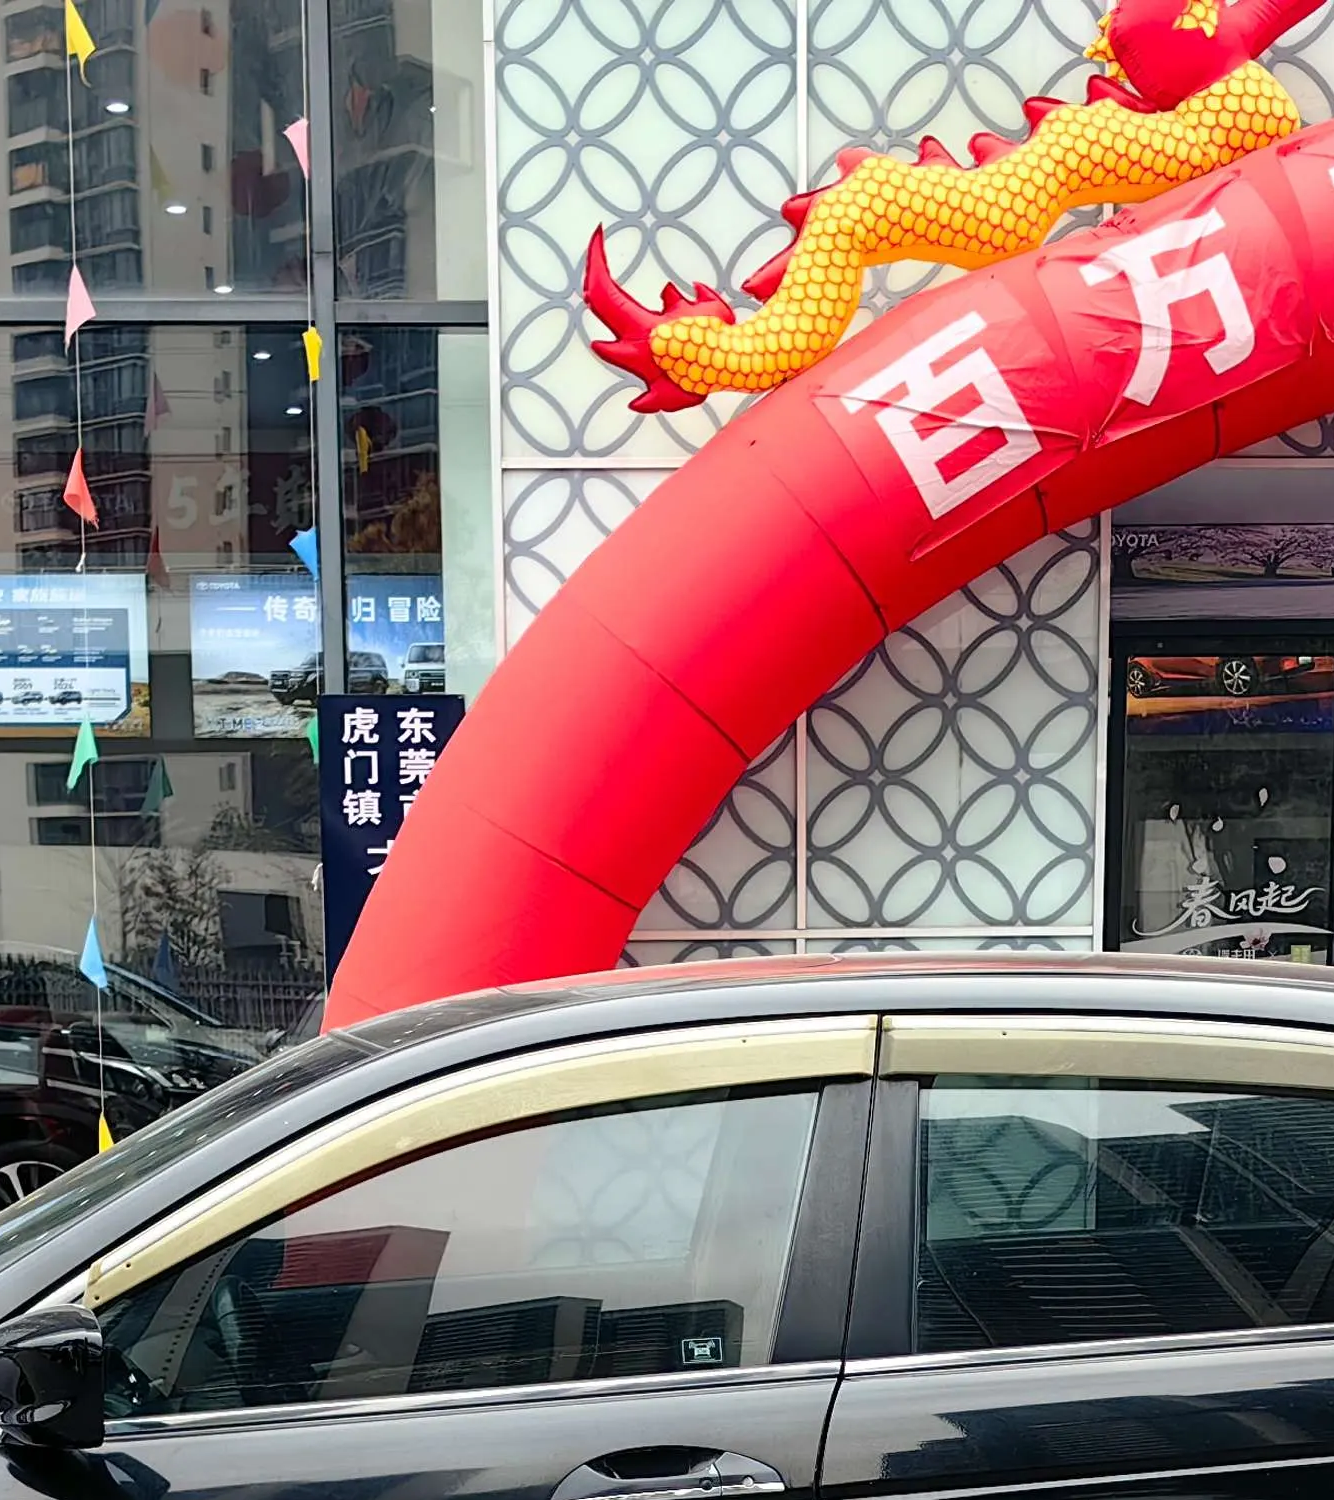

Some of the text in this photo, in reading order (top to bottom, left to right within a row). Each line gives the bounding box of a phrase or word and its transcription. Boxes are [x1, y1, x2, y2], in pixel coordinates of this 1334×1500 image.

[1111, 534, 1159, 547] YOTA
[388, 596, 442, 623] 冒险
[342, 707, 382, 826] 虎门镇
